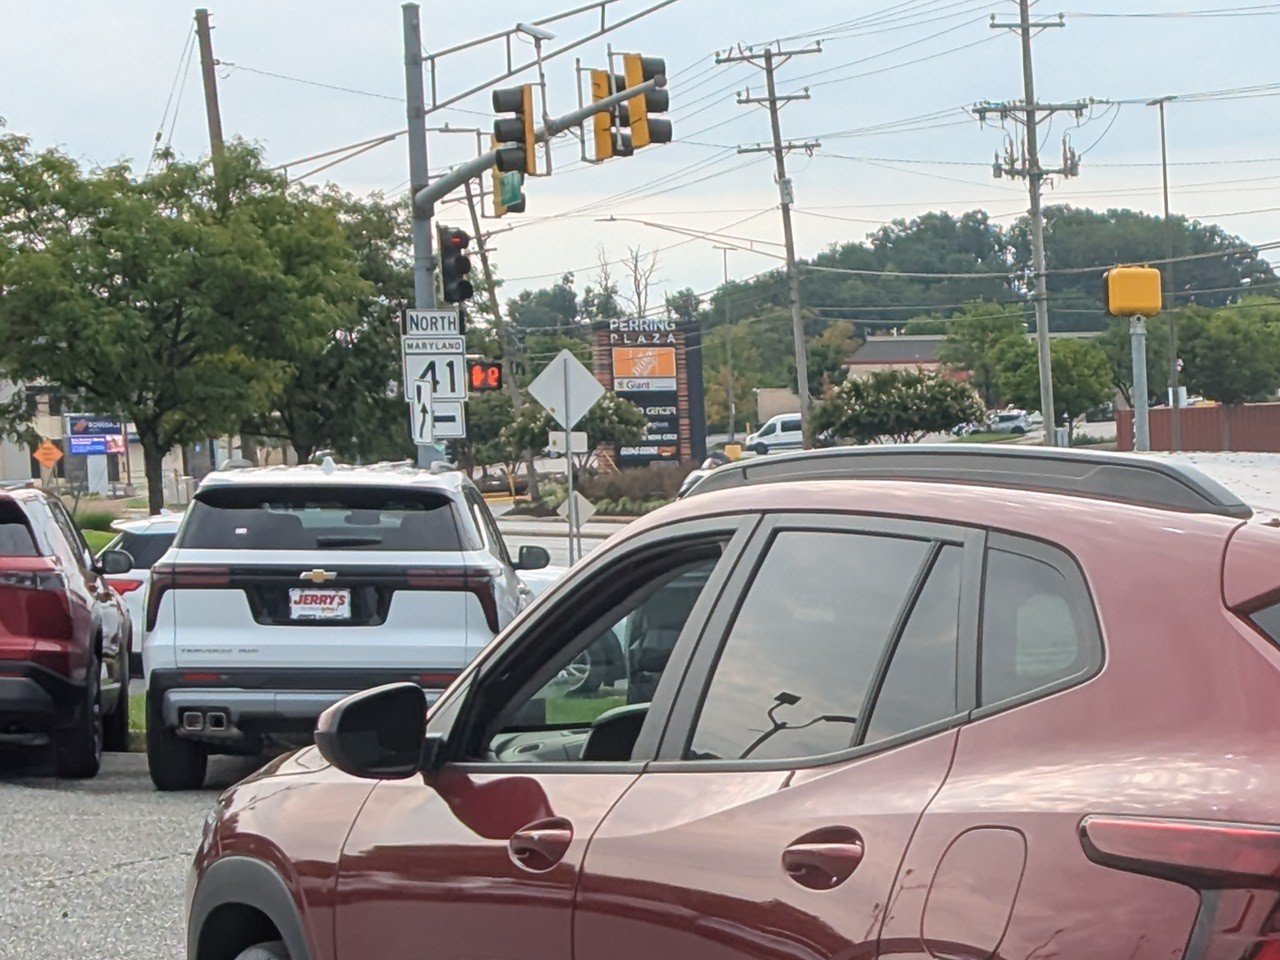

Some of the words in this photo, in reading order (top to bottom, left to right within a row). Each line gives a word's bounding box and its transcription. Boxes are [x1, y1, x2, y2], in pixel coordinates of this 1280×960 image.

[409, 314, 456, 331] NORTH
[609, 318, 676, 331] PERRING
[610, 333, 676, 344] PLAZA
[407, 342, 461, 350] MARYLAND
[418, 360, 456, 393] 41
[293, 594, 346, 606] JERRY'S
